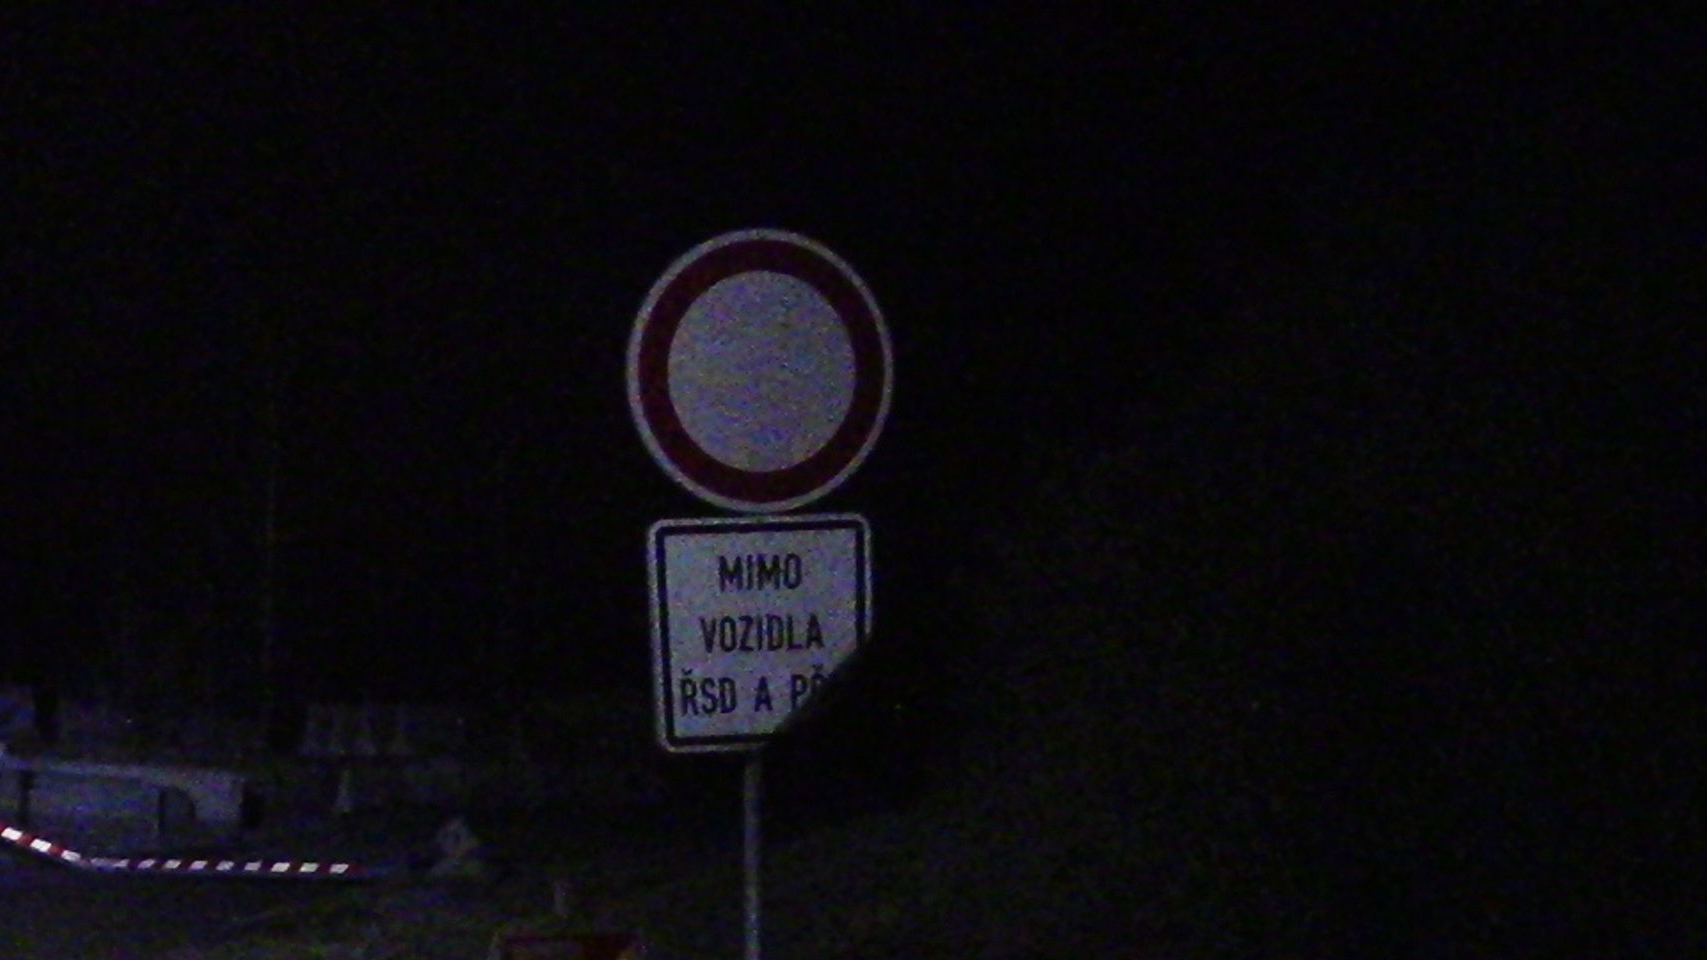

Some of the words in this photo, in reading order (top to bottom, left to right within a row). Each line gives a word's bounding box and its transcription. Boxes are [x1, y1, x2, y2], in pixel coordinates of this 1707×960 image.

[718, 553, 802, 592] MIMO
[699, 613, 825, 653] VOZIDLA
[679, 668, 737, 717] ŘSD
[754, 676, 773, 712] A
